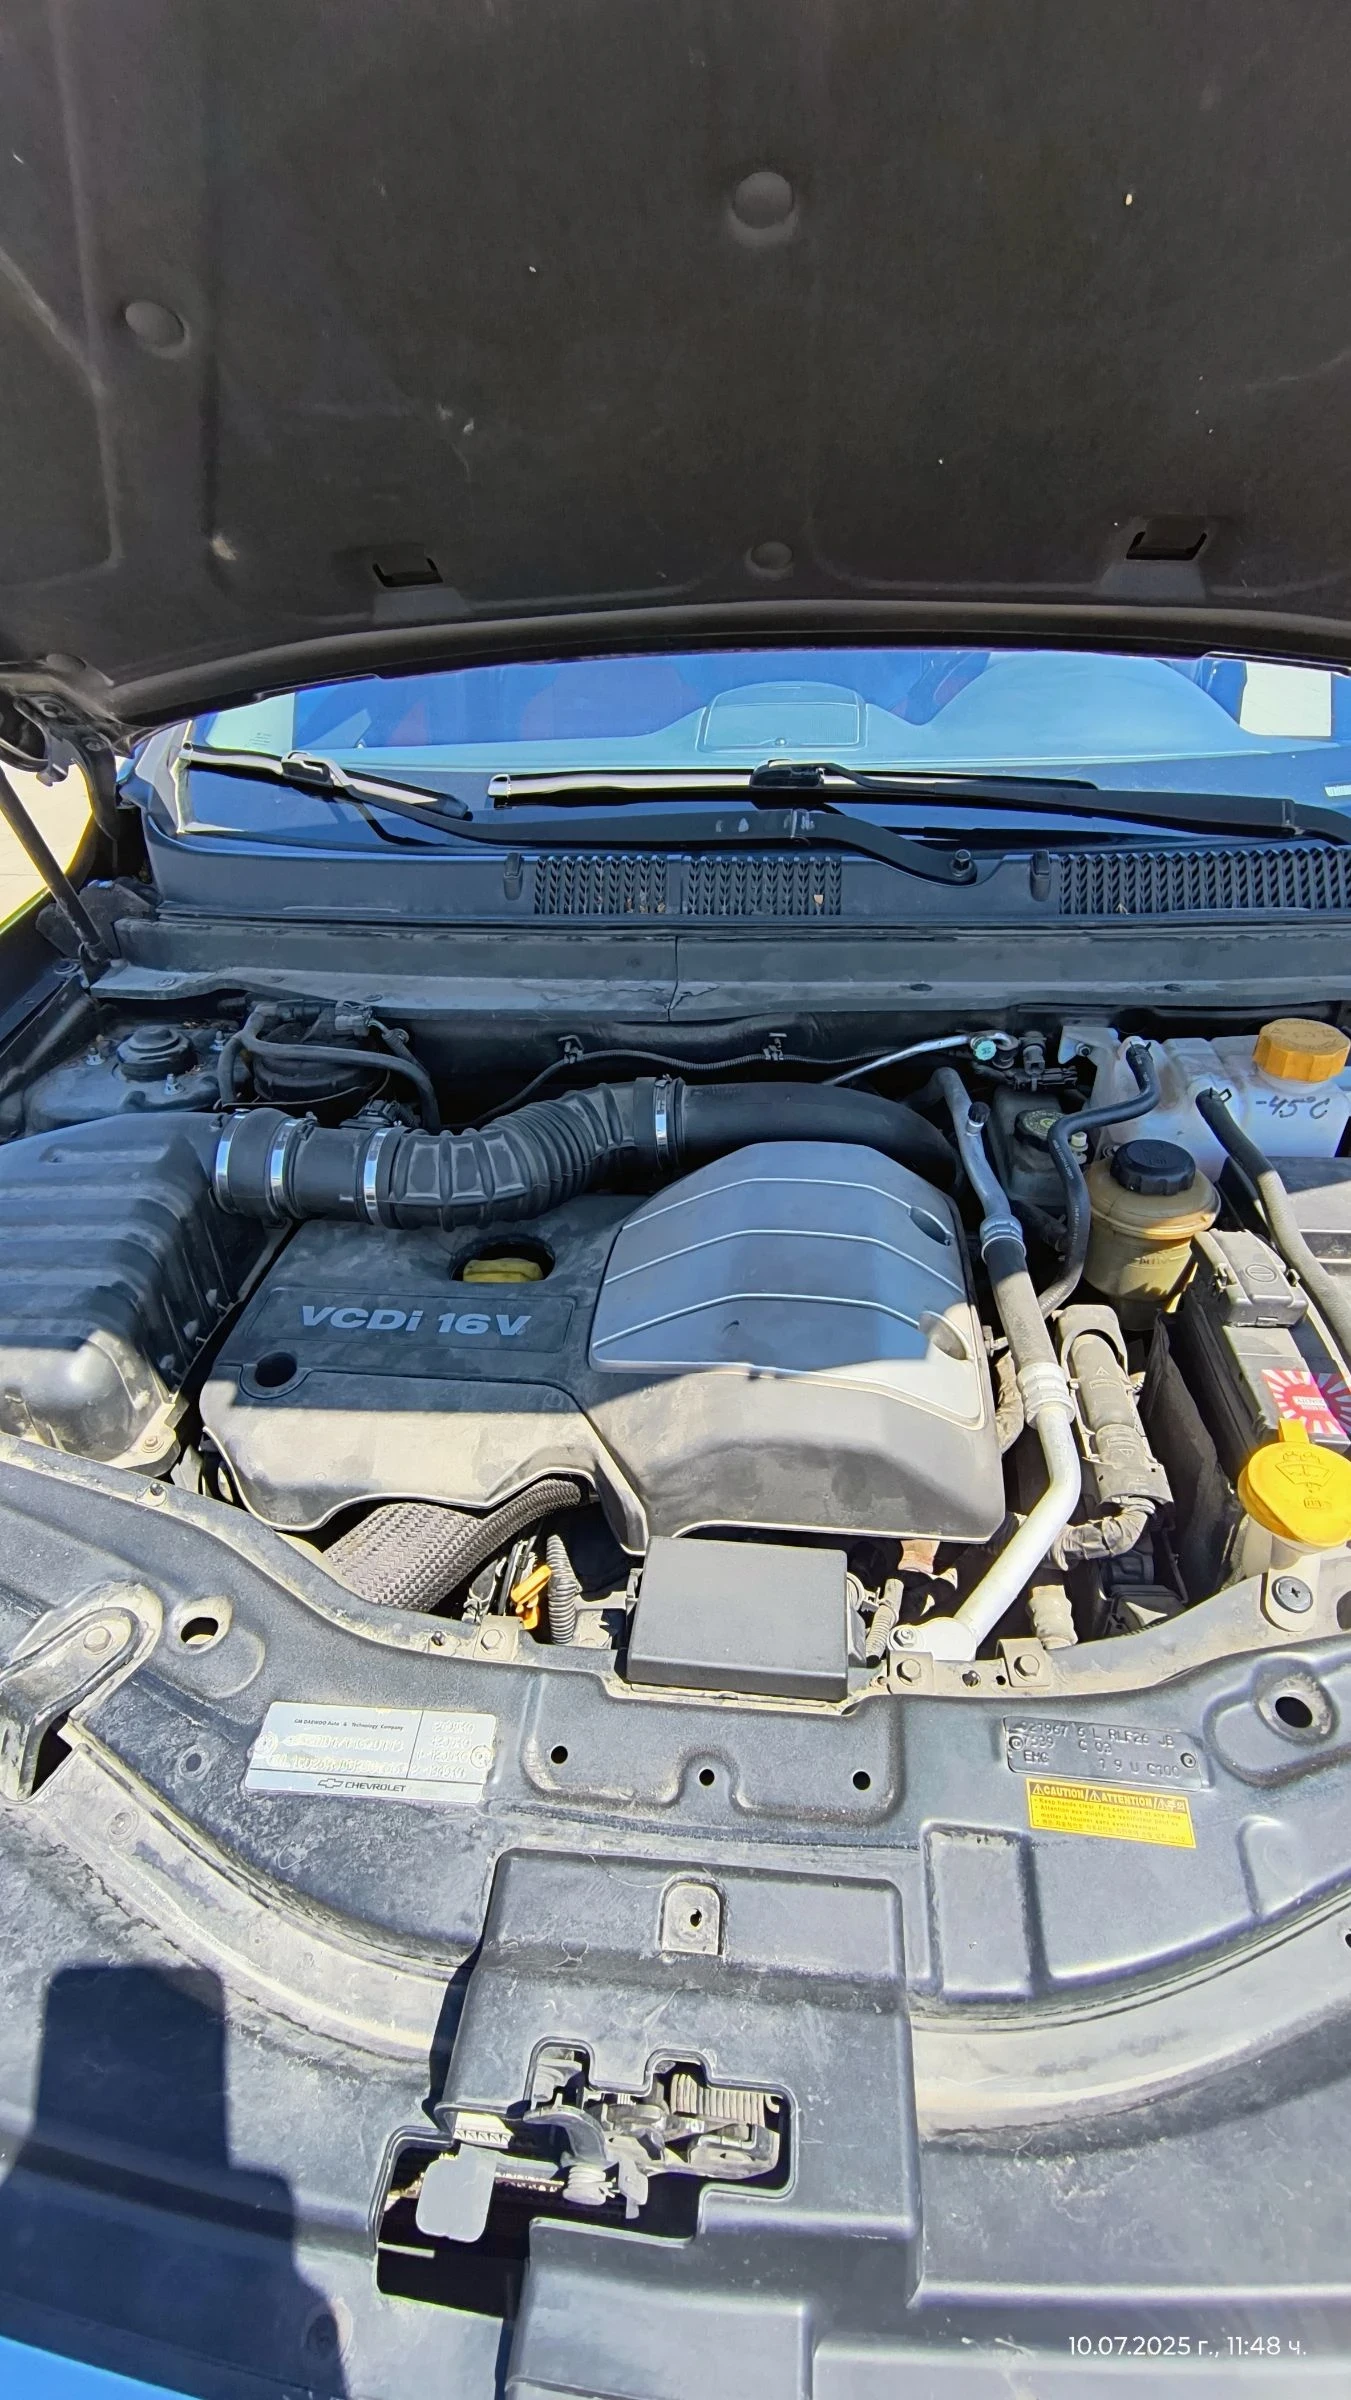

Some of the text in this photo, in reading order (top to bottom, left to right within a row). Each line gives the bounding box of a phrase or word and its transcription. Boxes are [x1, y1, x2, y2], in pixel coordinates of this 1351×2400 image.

[302, 1305, 532, 1336] VCDi 16V
[351, 1722, 378, 1730] Technology
[380, 1723, 404, 1731] Company
[345, 1781, 407, 1792] CHEVROLET
